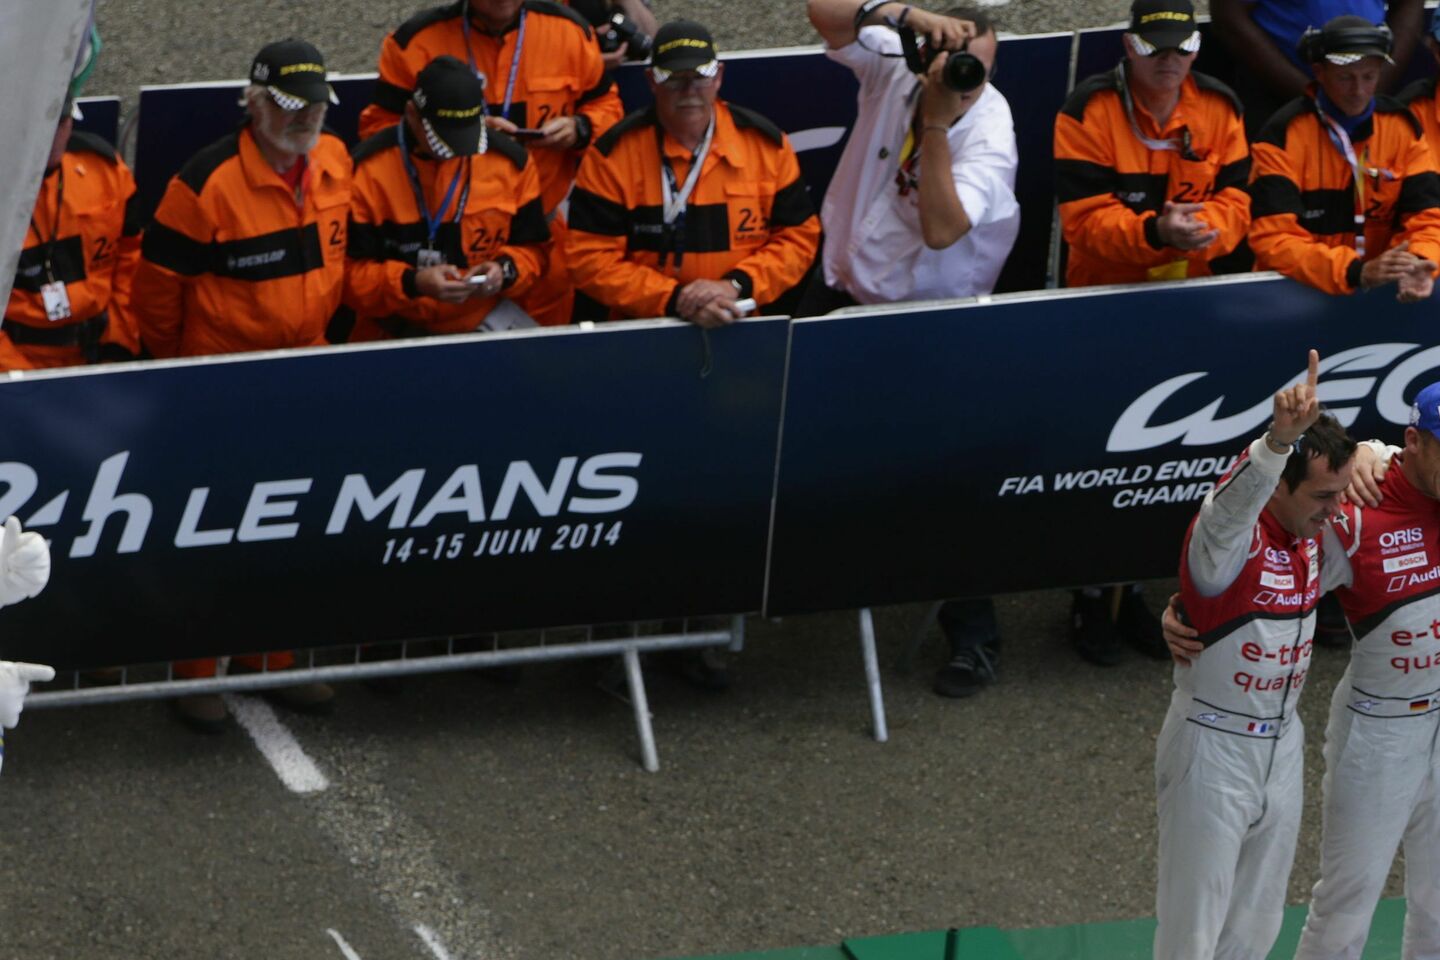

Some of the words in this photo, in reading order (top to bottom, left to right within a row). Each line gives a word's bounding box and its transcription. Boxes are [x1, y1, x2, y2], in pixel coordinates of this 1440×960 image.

[998, 475, 1044, 496] FIA
[1054, 466, 1152, 491] WORLD
[1154, 455, 1239, 481] ENDU
[174, 477, 313, 549] LE
[325, 452, 643, 535] MANS
[1112, 482, 1216, 508] CHAMP
[382, 533, 466, 565] 14-15
[472, 527, 542, 557] JUIN
[550, 520, 623, 551] 2014
[1379, 528, 1423, 547] ORIS
[1274, 593, 1302, 606] Audi
